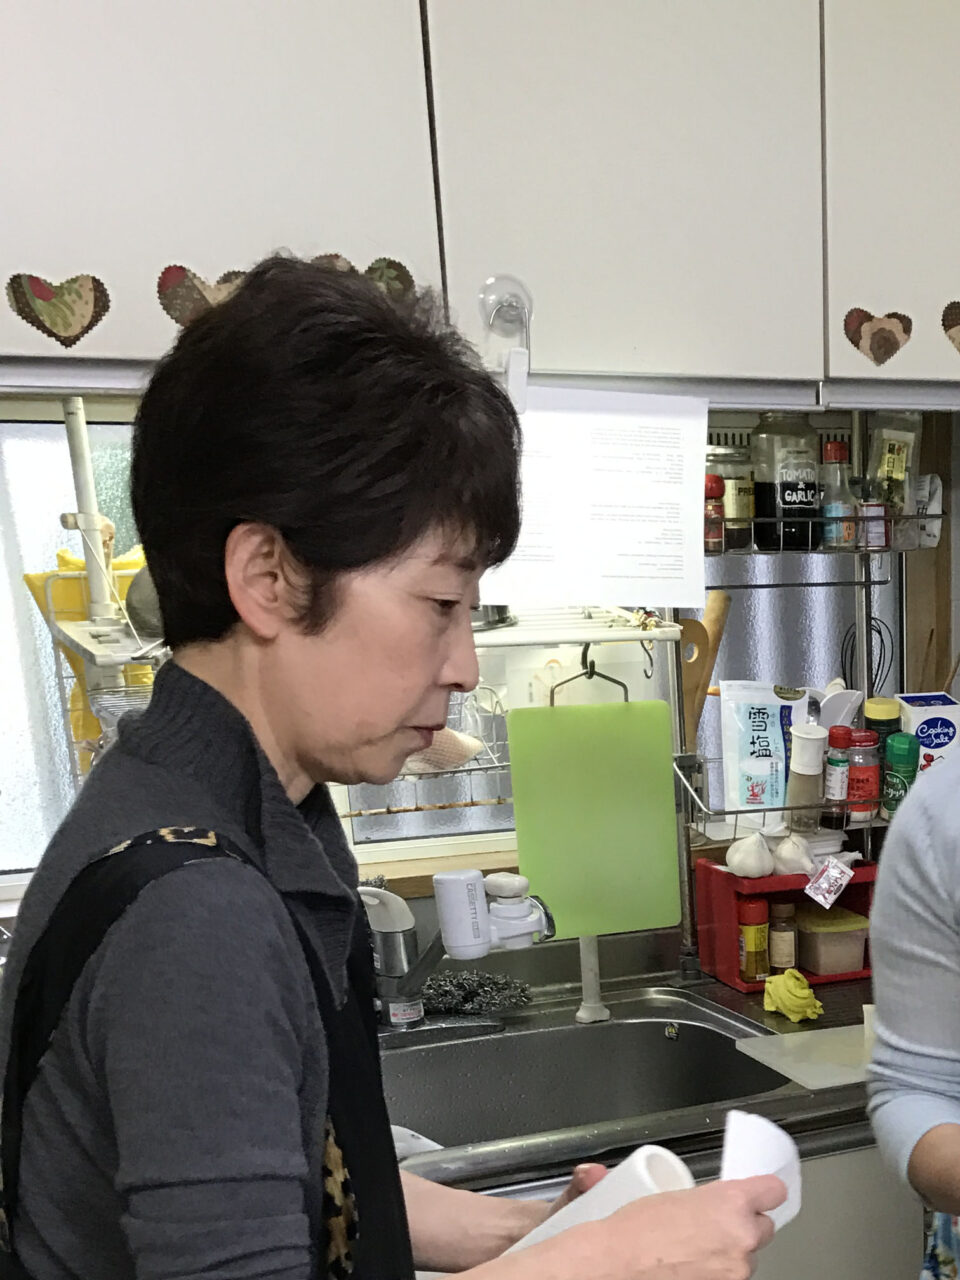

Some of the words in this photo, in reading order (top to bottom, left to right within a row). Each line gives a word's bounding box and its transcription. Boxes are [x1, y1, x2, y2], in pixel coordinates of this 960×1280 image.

[780, 468, 816, 481] TOMATO
[797, 481, 806, 489] &
[785, 490, 815, 503] GARLIC
[749, 706, 774, 759] 雪塩
[918, 720, 955, 737] Cooking
[930, 733, 950, 747] Salt
